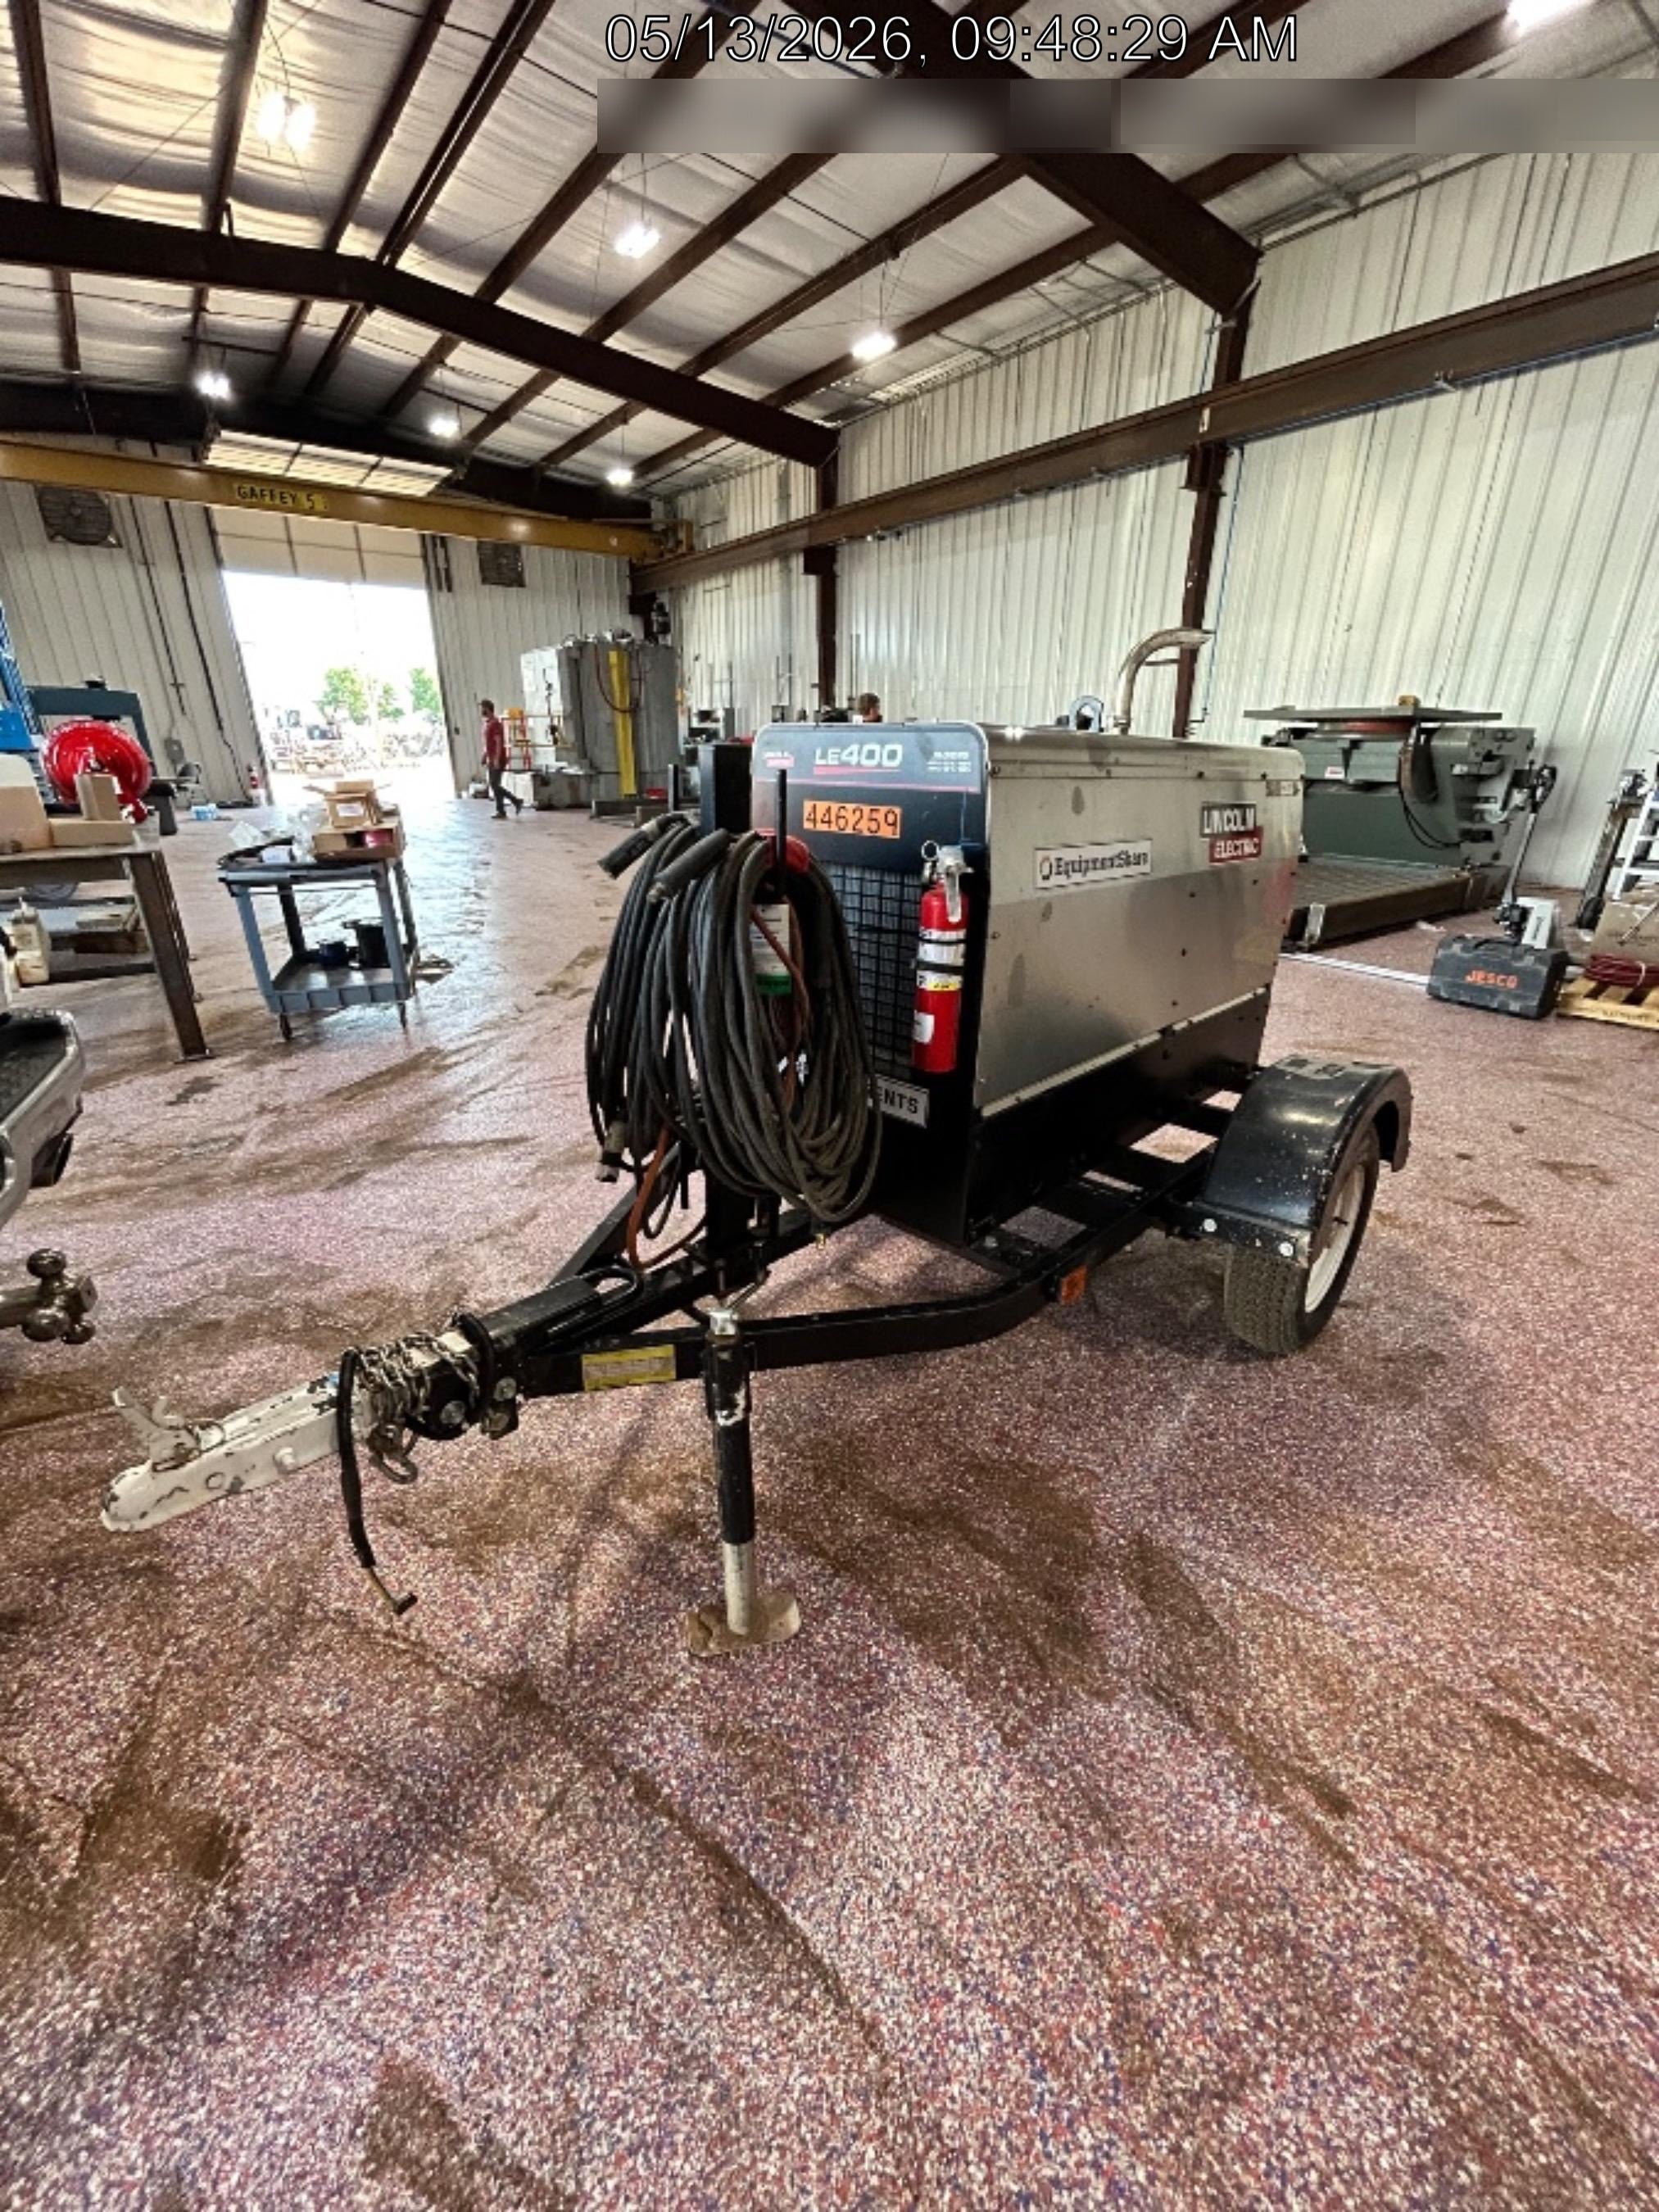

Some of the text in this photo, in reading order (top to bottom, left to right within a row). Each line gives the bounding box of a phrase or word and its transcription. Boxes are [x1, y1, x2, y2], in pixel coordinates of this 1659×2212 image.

[814, 744, 903, 768] LE400
[805, 803, 899, 836] 446259
[1203, 807, 1255, 834] LINCOLN
[1213, 837, 1260, 859] ELECTRIC
[1465, 969, 1518, 989] JESCO
